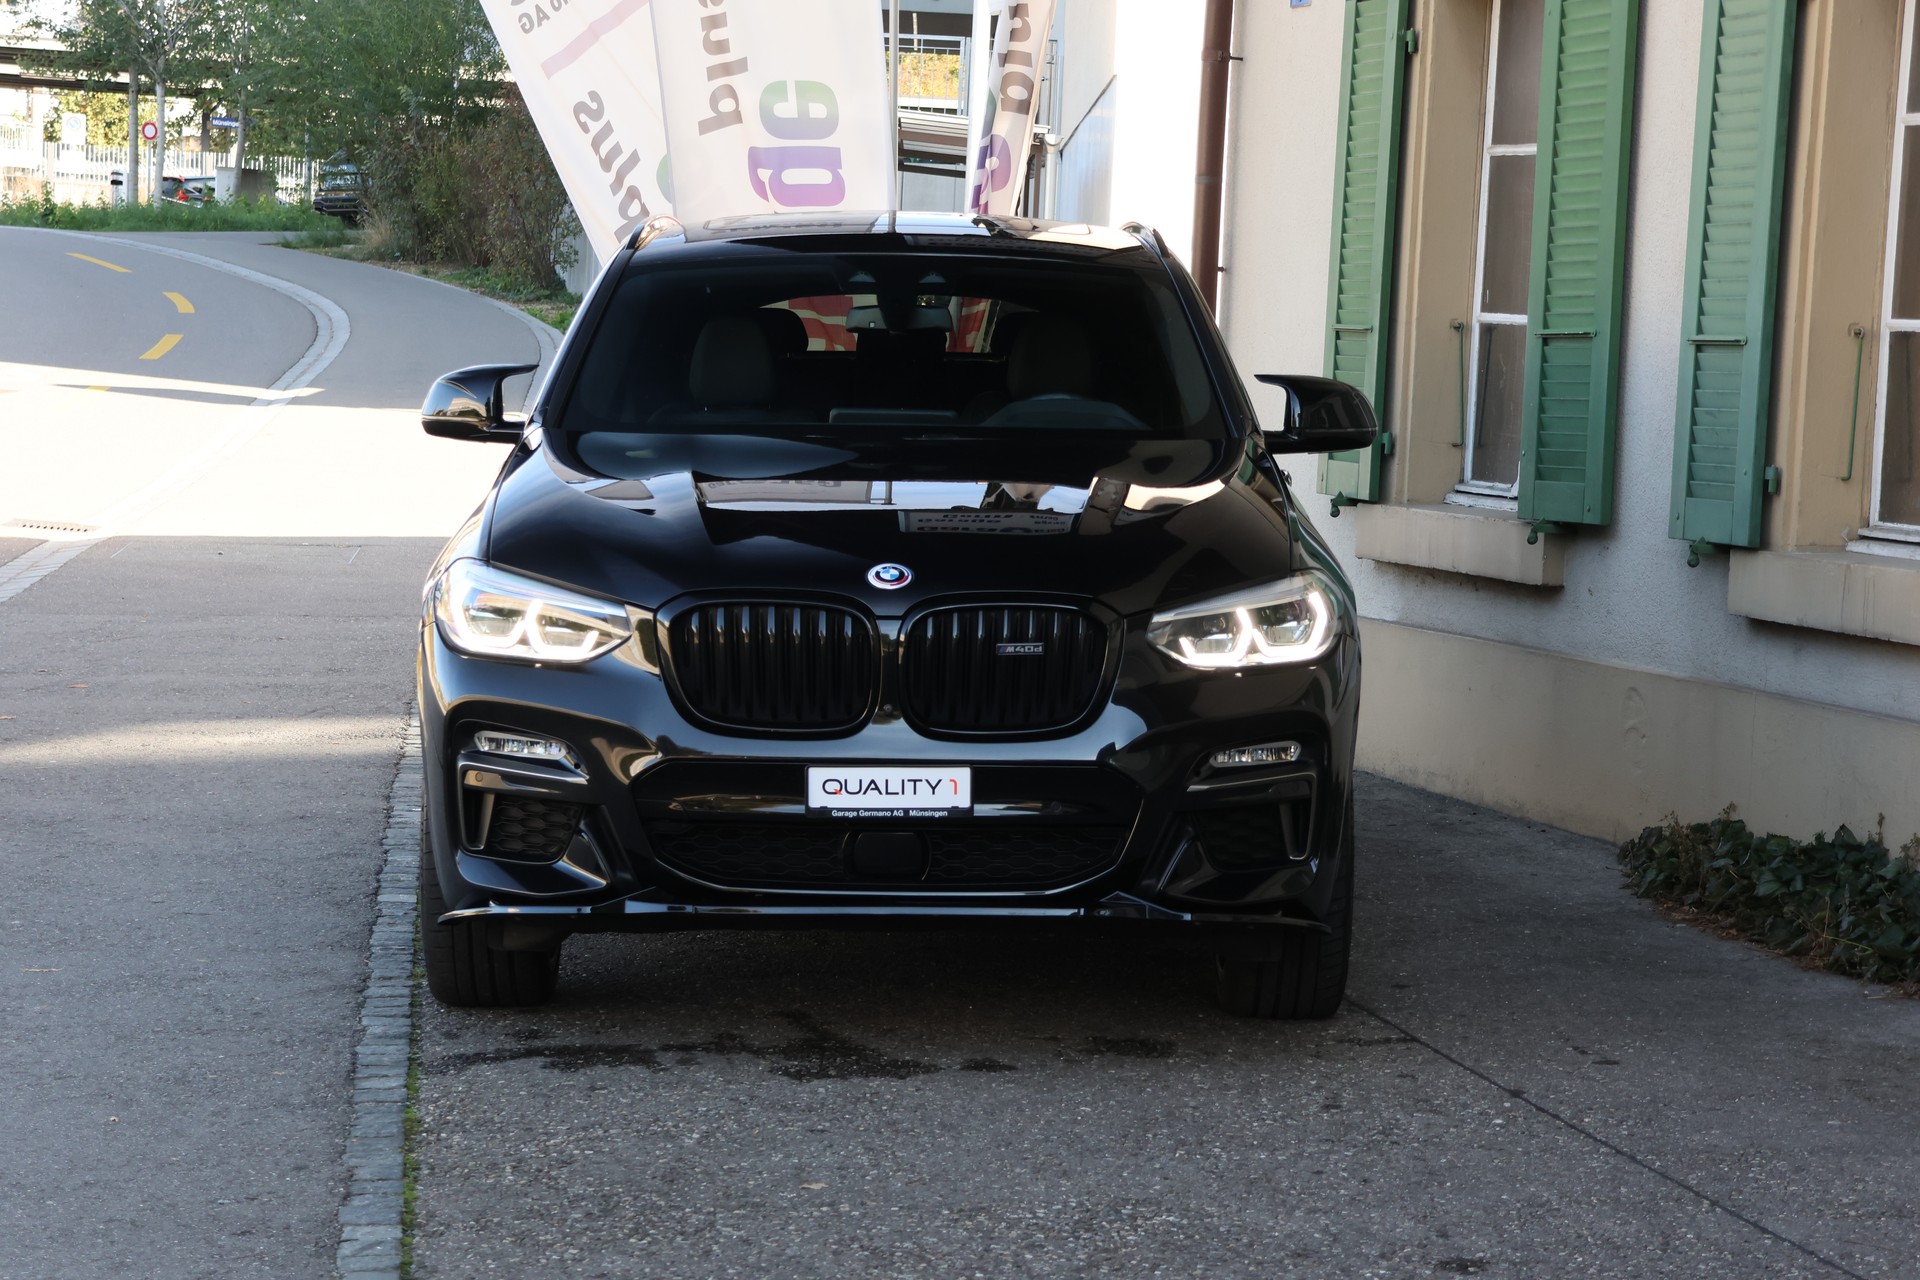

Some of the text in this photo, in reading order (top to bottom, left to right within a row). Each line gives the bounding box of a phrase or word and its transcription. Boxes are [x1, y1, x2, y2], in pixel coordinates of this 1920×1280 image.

[822, 779, 957, 795] QUALITY 1
[832, 810, 857, 818] Garage
[909, 809, 948, 818] Münsingen
